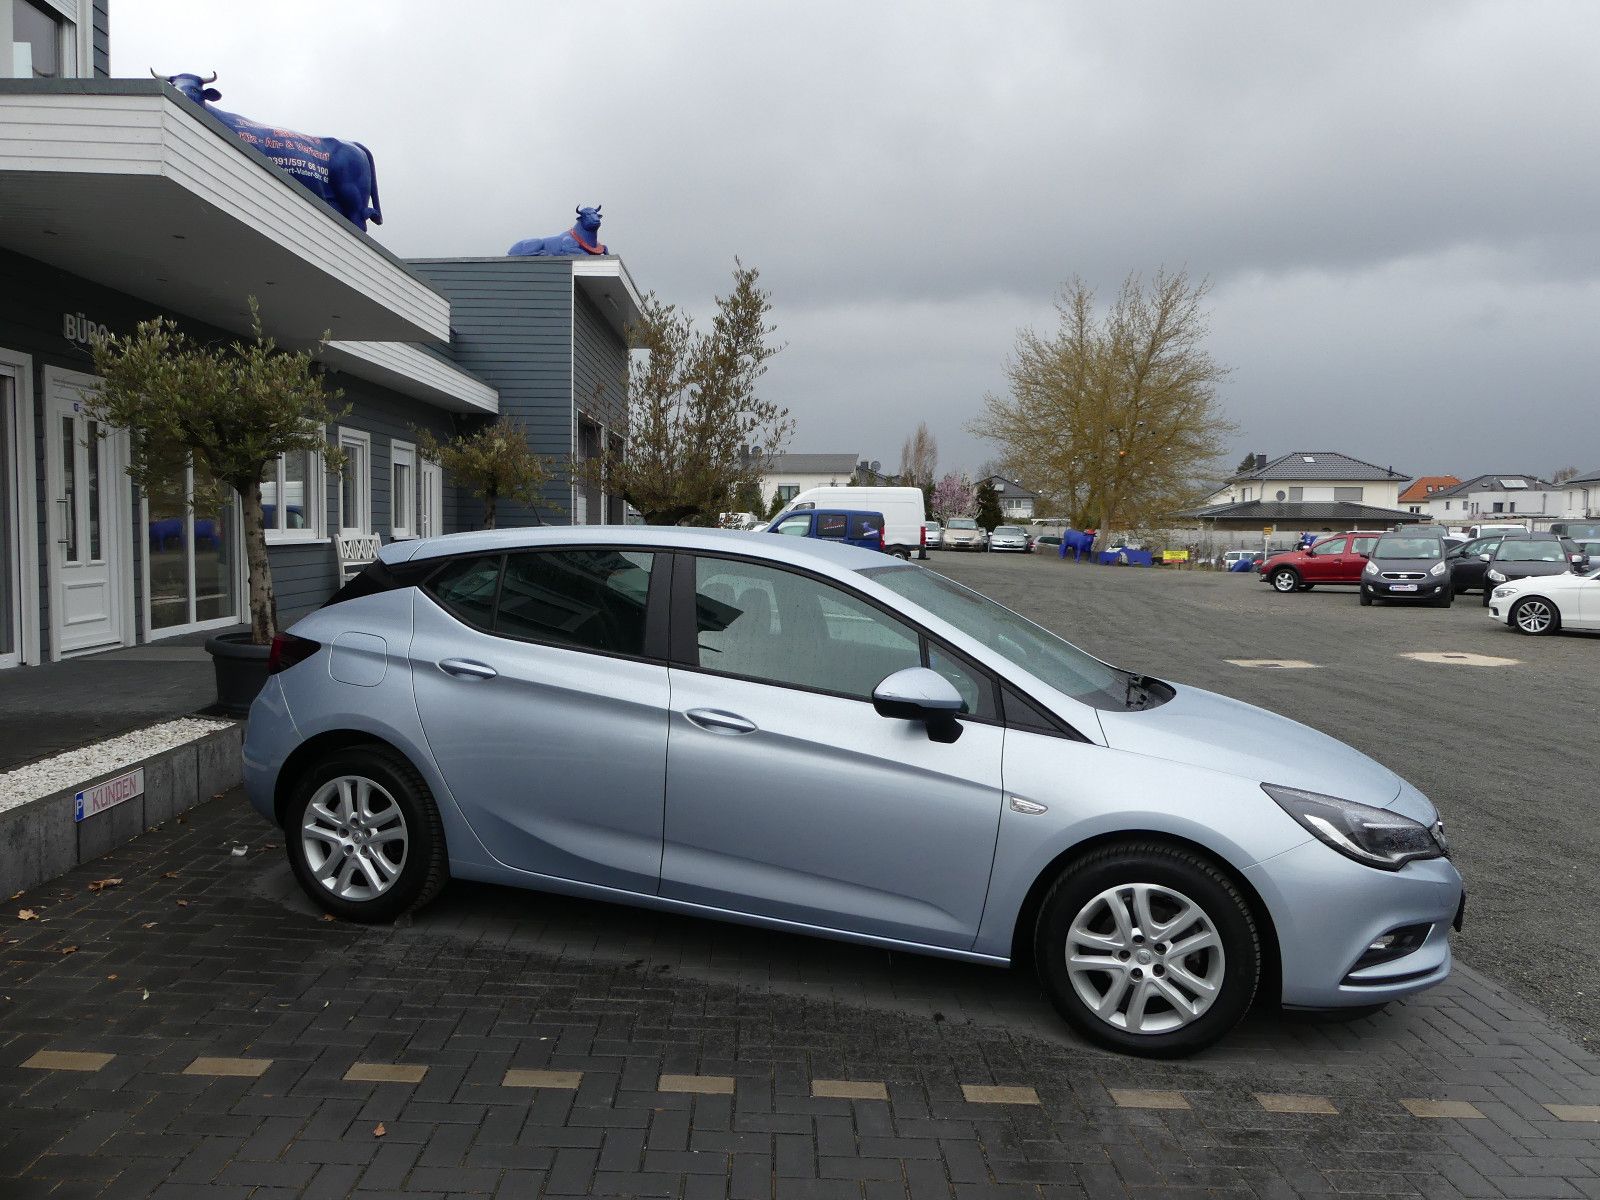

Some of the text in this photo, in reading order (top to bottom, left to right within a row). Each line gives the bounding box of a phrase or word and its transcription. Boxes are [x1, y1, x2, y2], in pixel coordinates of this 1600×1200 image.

[286, 139, 295, 150] &
[317, 165, 329, 176] 100
[76, 774, 137, 816] P KUNDEN
